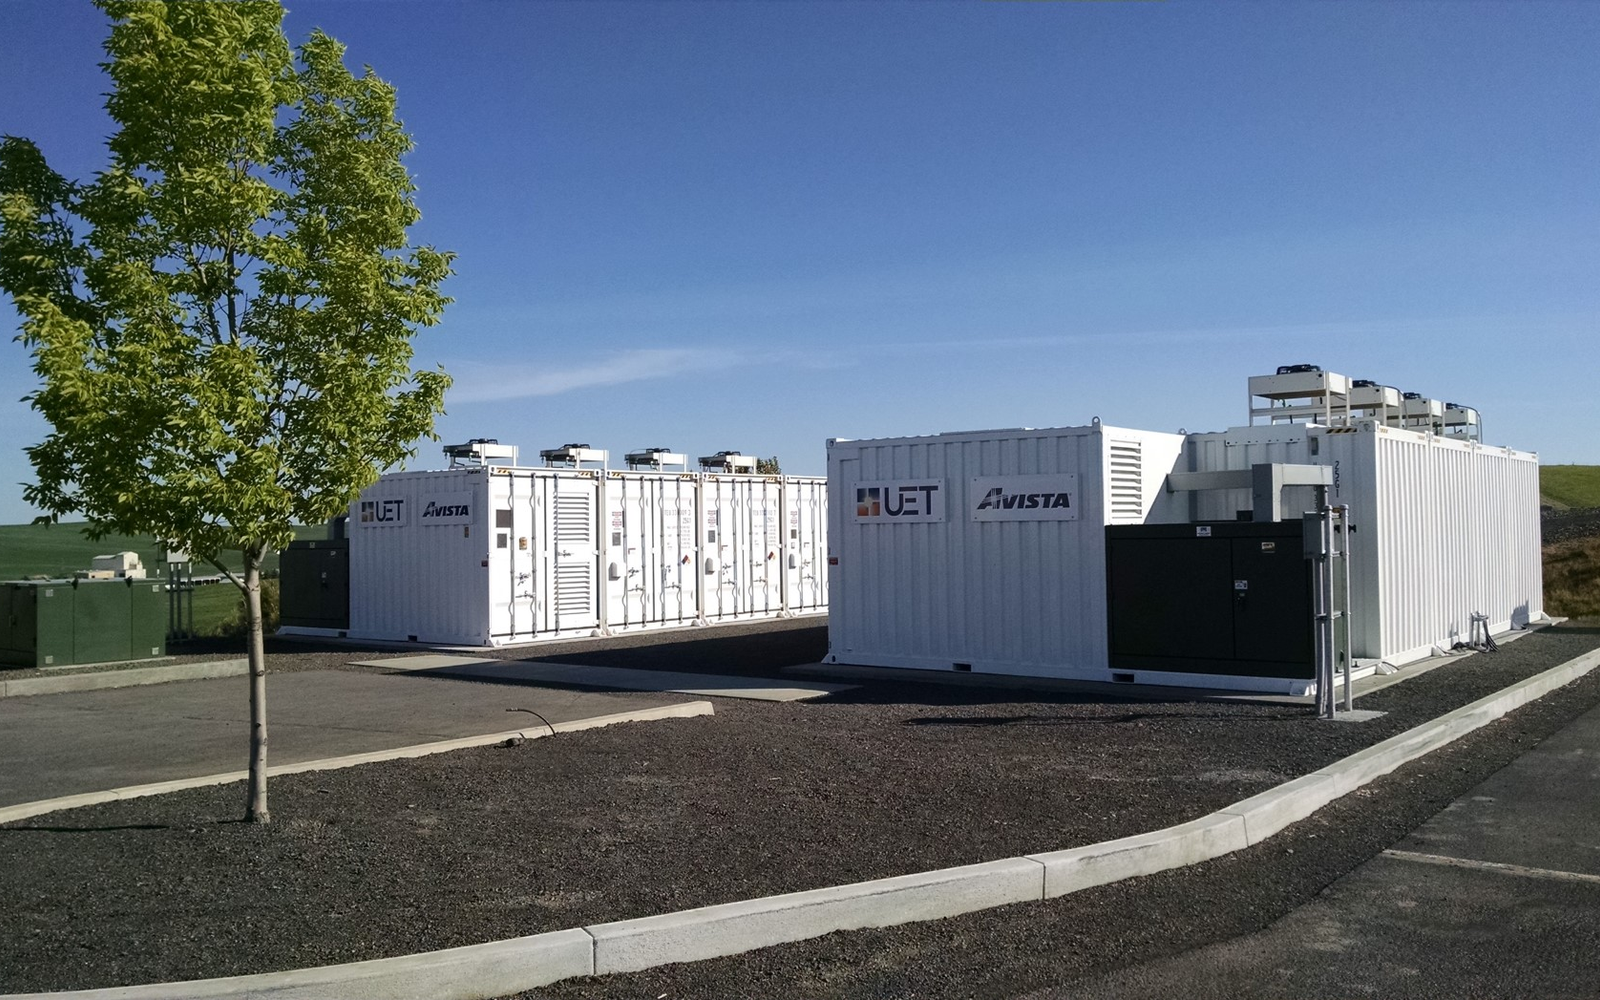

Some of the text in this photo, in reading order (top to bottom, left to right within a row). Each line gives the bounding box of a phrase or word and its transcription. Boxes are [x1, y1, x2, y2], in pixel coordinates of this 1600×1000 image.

[422, 501, 470, 517] AVISTA
[884, 485, 939, 517] UET
[976, 487, 1070, 510] AVISTA
[376, 499, 404, 522] UET
